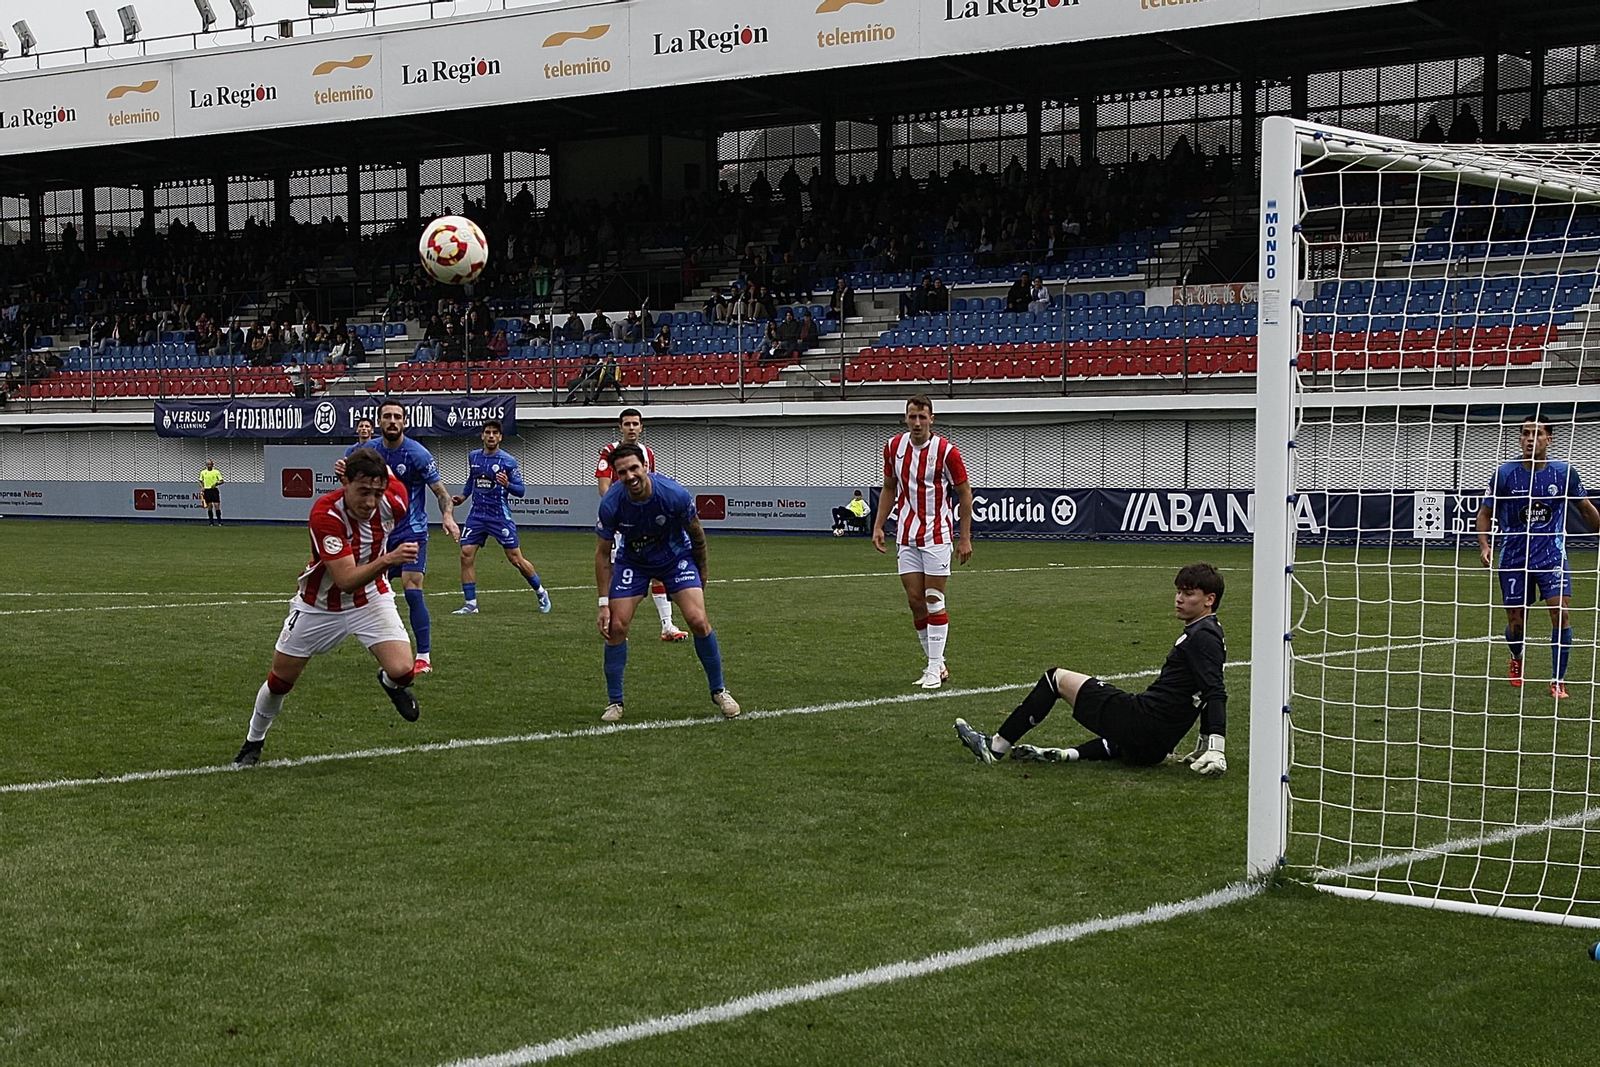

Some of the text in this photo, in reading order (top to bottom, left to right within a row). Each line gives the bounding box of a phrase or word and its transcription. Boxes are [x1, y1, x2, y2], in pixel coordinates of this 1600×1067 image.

[944, 0, 980, 21] La
[653, 23, 768, 56] La Región
[816, 23, 896, 48] telemiño
[401, 56, 500, 86] La Región
[543, 56, 611, 79] telemiño
[189, 83, 277, 109] La Región
[313, 85, 374, 105] telemiño
[0, 105, 76, 129] La Región
[108, 107, 160, 127] telemiño
[1265, 212, 1278, 280] MONDO
[171, 410, 211, 423] VERSUS
[236, 404, 303, 430] FEDERACIÓN
[362, 401, 433, 428] FECIÓN
[457, 406, 505, 420] VERSUS
[462, 419, 487, 428] E-LEAR
[0, 490, 43, 499] presa Nieto
[156, 492, 190, 501] Empresa
[507, 497, 570, 507] mpresa Nieto
[727, 498, 807, 510] Empresa Nieto
[971, 495, 1046, 523] Galicia
[461, 526, 473, 538] 17
[621, 568, 634, 585] 9
[1508, 578, 1517, 595] 7
[287, 609, 301, 632] 4
